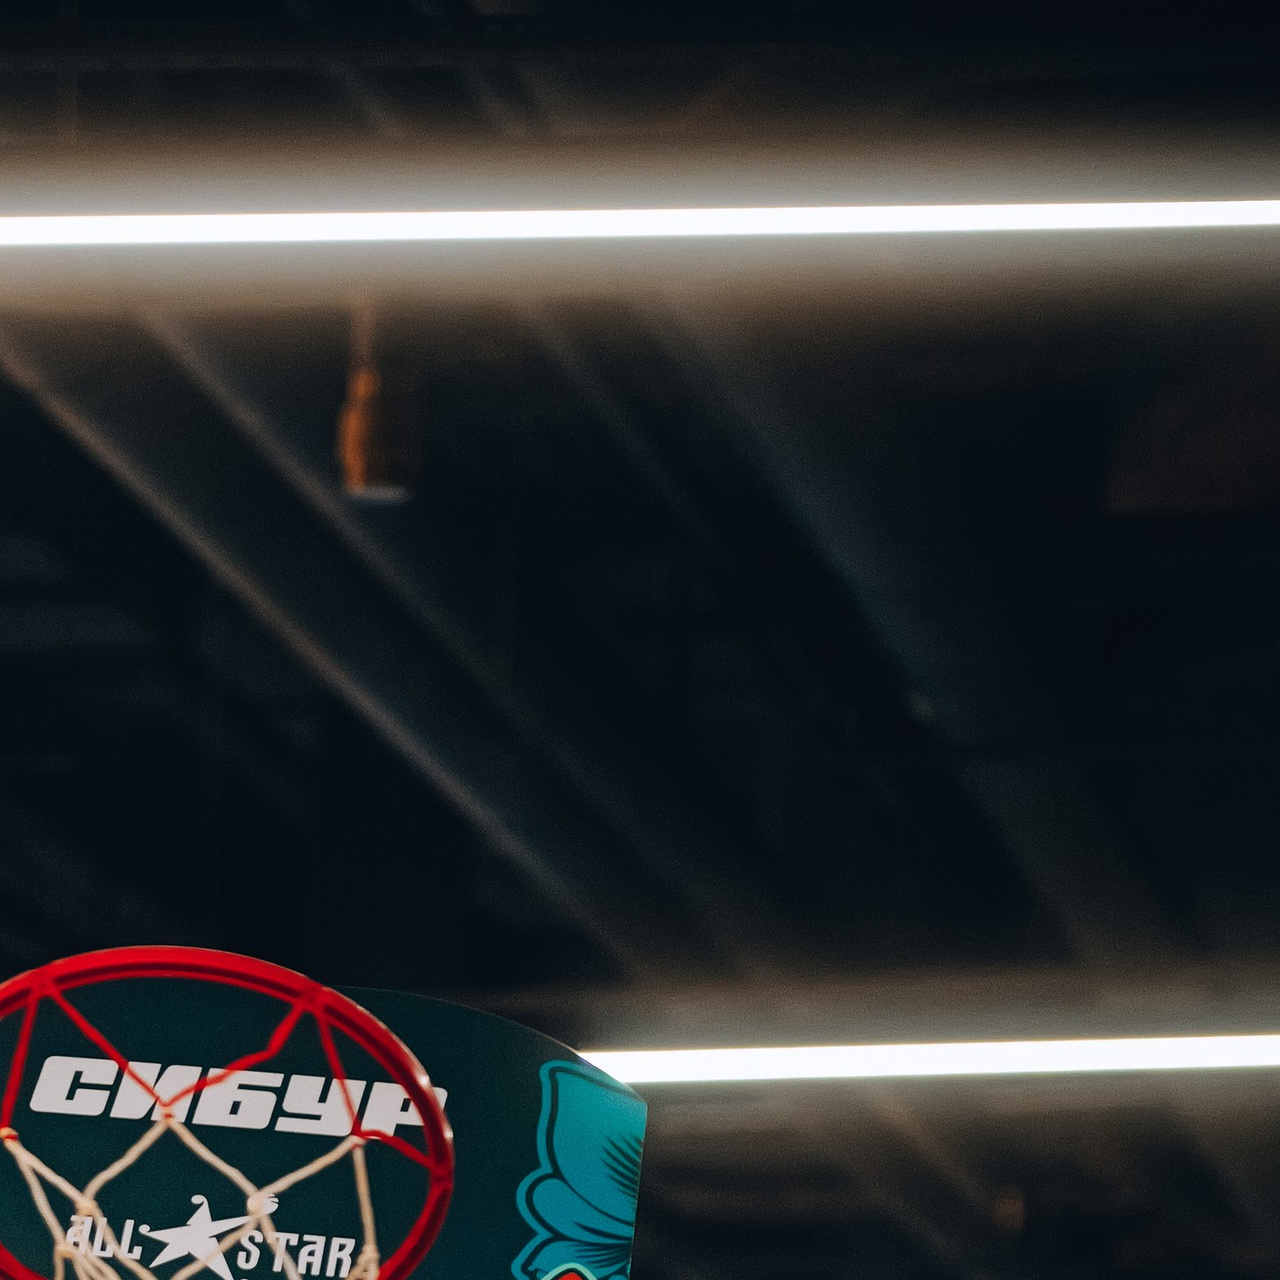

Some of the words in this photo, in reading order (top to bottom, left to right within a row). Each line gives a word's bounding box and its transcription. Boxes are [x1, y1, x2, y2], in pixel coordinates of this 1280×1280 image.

[29, 1055, 448, 1138] СИБУР
[66, 1214, 142, 1260] ALL
[236, 1229, 356, 1279] STAR
